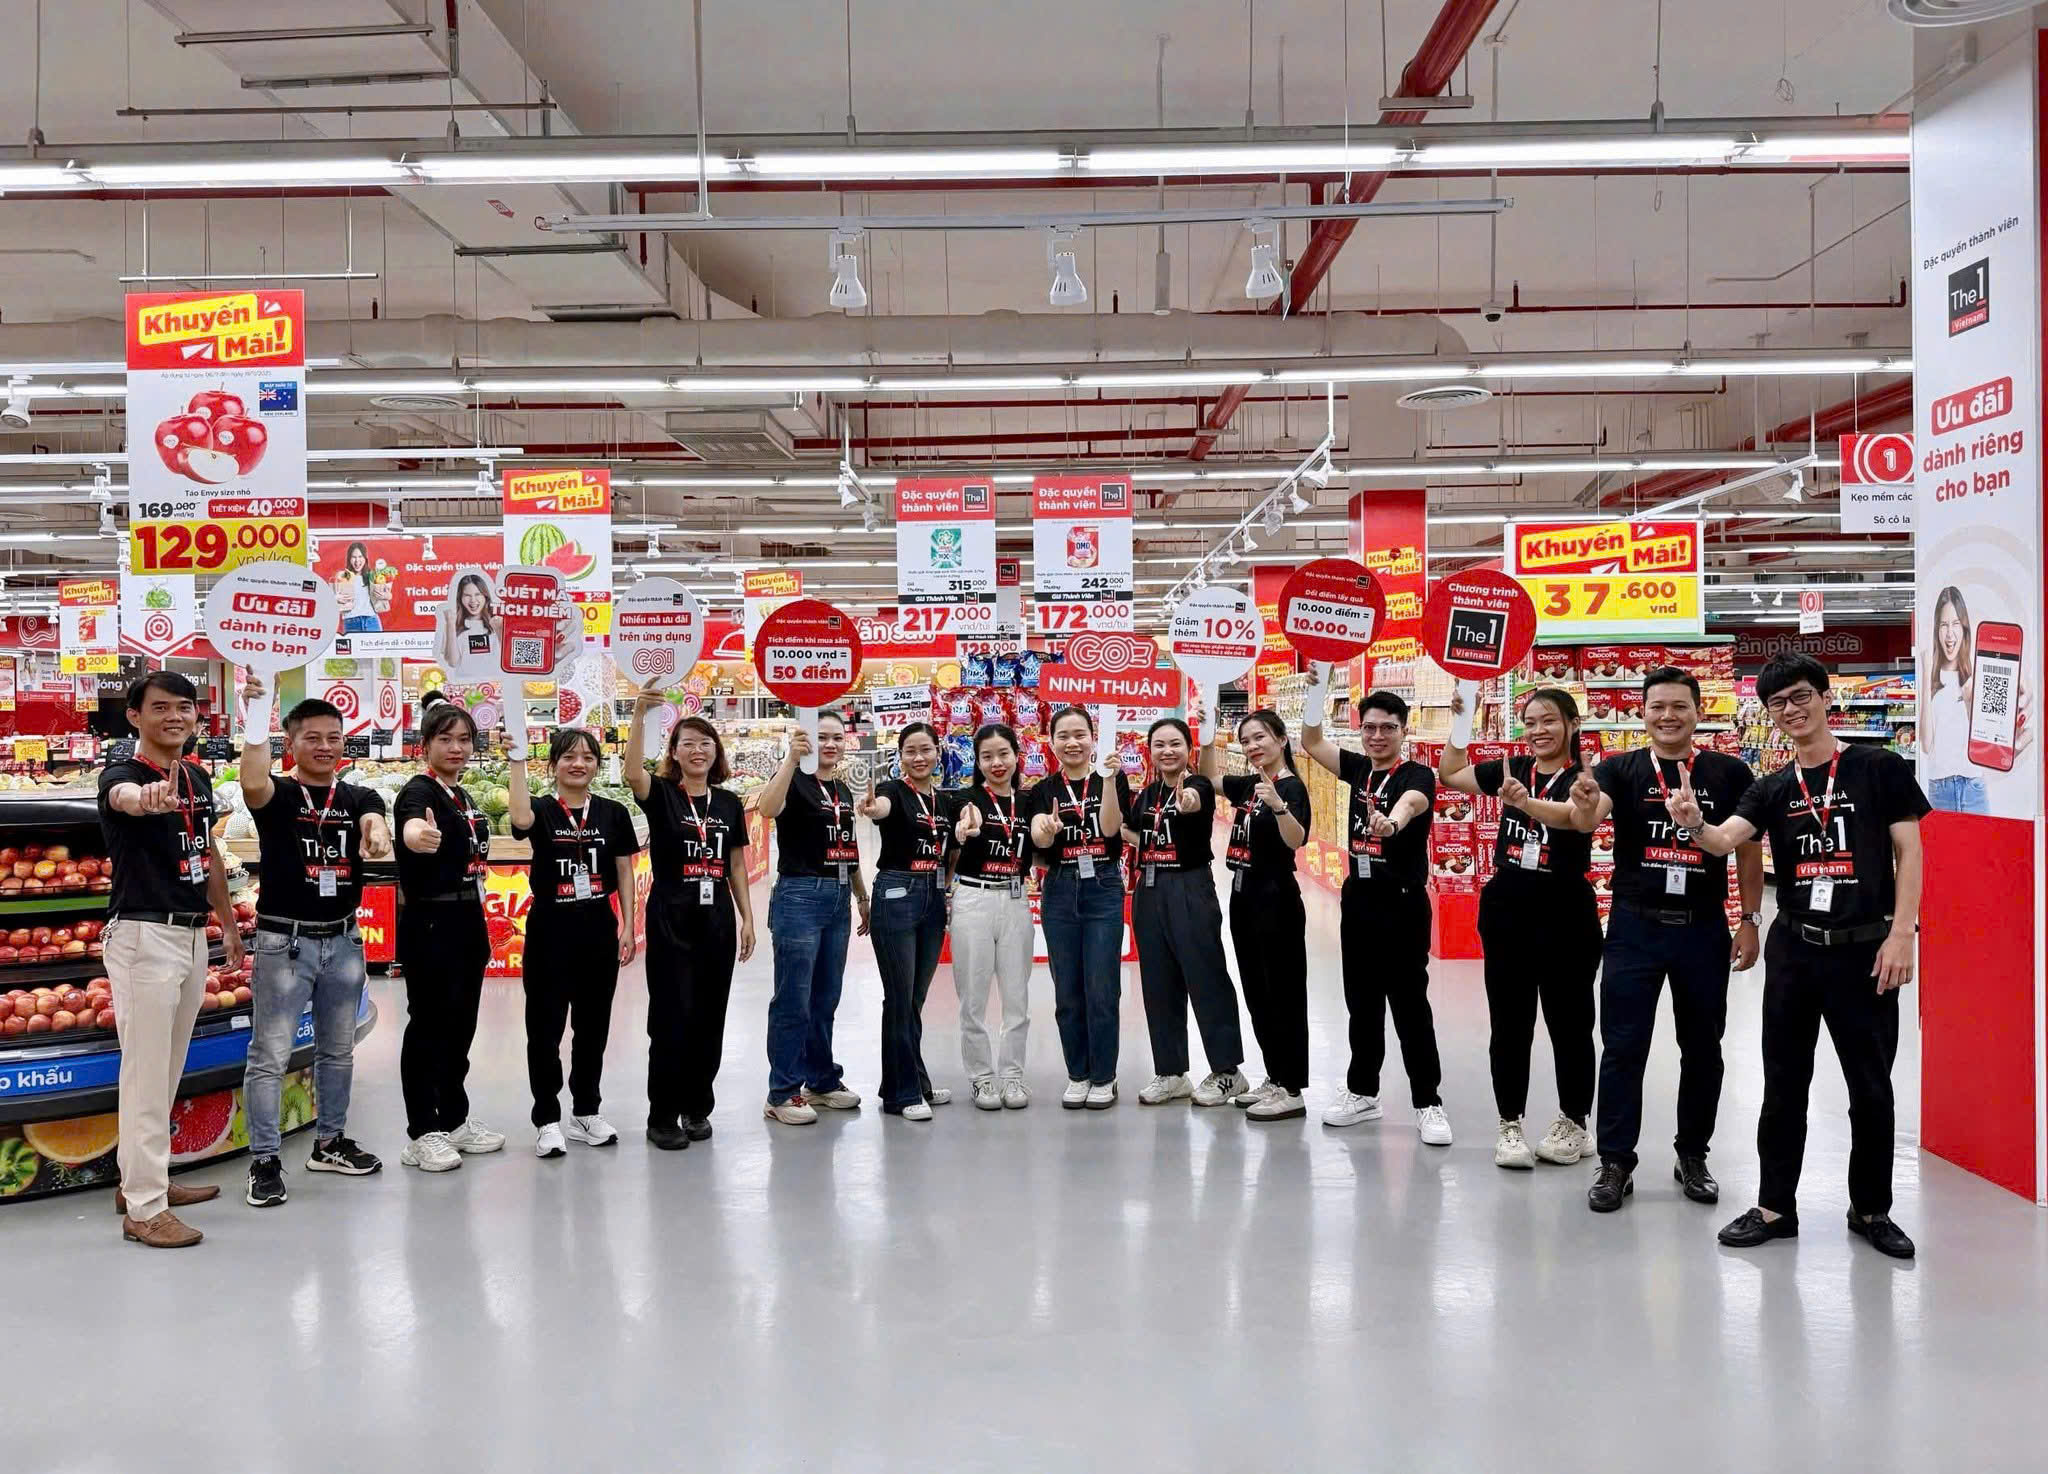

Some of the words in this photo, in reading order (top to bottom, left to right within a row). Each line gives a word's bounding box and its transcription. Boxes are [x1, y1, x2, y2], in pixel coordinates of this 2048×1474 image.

[1923, 256, 1939, 270] Đặc
[1940, 240, 1967, 262] quyền
[1969, 227, 1995, 247] thành
[1998, 216, 2019, 233] viên
[144, 301, 250, 336] Khuyến
[225, 319, 286, 358] Mãi!
[1936, 399, 1964, 429] Ưu
[1970, 383, 2004, 419] đãi
[1884, 448, 1896, 471] 1
[1923, 442, 1966, 473] dành
[1971, 430, 2023, 461] riêng
[513, 475, 578, 495] Khuyến
[1039, 488, 1060, 498] Đặc
[1062, 486, 1097, 498] quyền
[1936, 479, 1967, 502] cho
[1973, 469, 2010, 497] bạn
[185, 489, 199, 498] Táo
[201, 489, 218, 499] Envy
[562, 486, 600, 509] Mãi!
[902, 490, 923, 500] Đặc
[925, 488, 960, 501] quyền
[1851, 493, 1869, 504] Kẹo
[1871, 491, 1895, 502] mềm
[1897, 491, 1913, 502] các
[138, 502, 196, 518] 169.000
[247, 498, 298, 516] 40.000
[902, 502, 934, 512] thành
[936, 502, 959, 512] viên
[1039, 500, 1071, 510] thành
[1073, 500, 1096, 510] viên
[1873, 515, 1886, 524] Sô
[1889, 515, 1900, 524] cô
[1902, 515, 1911, 524] la
[135, 524, 301, 569] 129.000
[1076, 542, 1091, 550] OMO
[1526, 529, 1625, 560] Khuyến
[1633, 539, 1687, 566] Mãi!
[405, 563, 423, 573] Đặc
[425, 562, 453, 573] quyền
[64, 584, 100, 596] Khuyến
[405, 586, 429, 597] Tích
[496, 584, 542, 600] QUÉT
[1318, 590, 1337, 599] điểm
[1448, 583, 1490, 595] Chương
[1492, 587, 1518, 597] trình
[239, 595, 269, 612] Ưu
[274, 600, 309, 616] đãi
[490, 601, 528, 617] TÍCH
[531, 602, 573, 619] ĐIỂM
[1297, 602, 1333, 615] 10.000
[1334, 608, 1361, 619] điểm
[1453, 595, 1483, 607] thành
[1486, 598, 1510, 609] viên
[1650, 603, 1678, 613] vnd
[622, 615, 646, 625] Nhiều
[903, 607, 992, 632] 217.000
[1038, 604, 1129, 630] 172.000
[219, 619, 267, 634] dành
[273, 624, 321, 640] riêng
[859, 619, 888, 641] ăn
[1174, 629, 1199, 638] thêm
[1175, 617, 1199, 626] Giảm
[1204, 618, 1256, 640] 10%
[1293, 617, 1348, 636] 10.000
[1349, 631, 1366, 639] vnd
[620, 632, 640, 642] trên
[643, 631, 663, 643] ứng
[665, 632, 692, 644] dụng
[1827, 633, 1860, 652] sữa
[231, 638, 266, 652] cho
[272, 641, 307, 657] bạn
[772, 650, 813, 659] 10.000
[816, 650, 837, 659] vnd
[1455, 648, 1492, 661] Vietnam
[772, 665, 797, 679] 50
[801, 661, 847, 679] điểm
[1049, 677, 1096, 693] NINH
[1100, 677, 1167, 700] THUẬN
[1116, 708, 1158, 722] 72.000
[1436, 793, 1470, 801] ChocoPie
[1648, 820, 1691, 841] The
[1436, 845, 1471, 853] ChocoPie
[1651, 848, 1698, 861] Vietnam
[18, 1065, 73, 1088] khẩu
